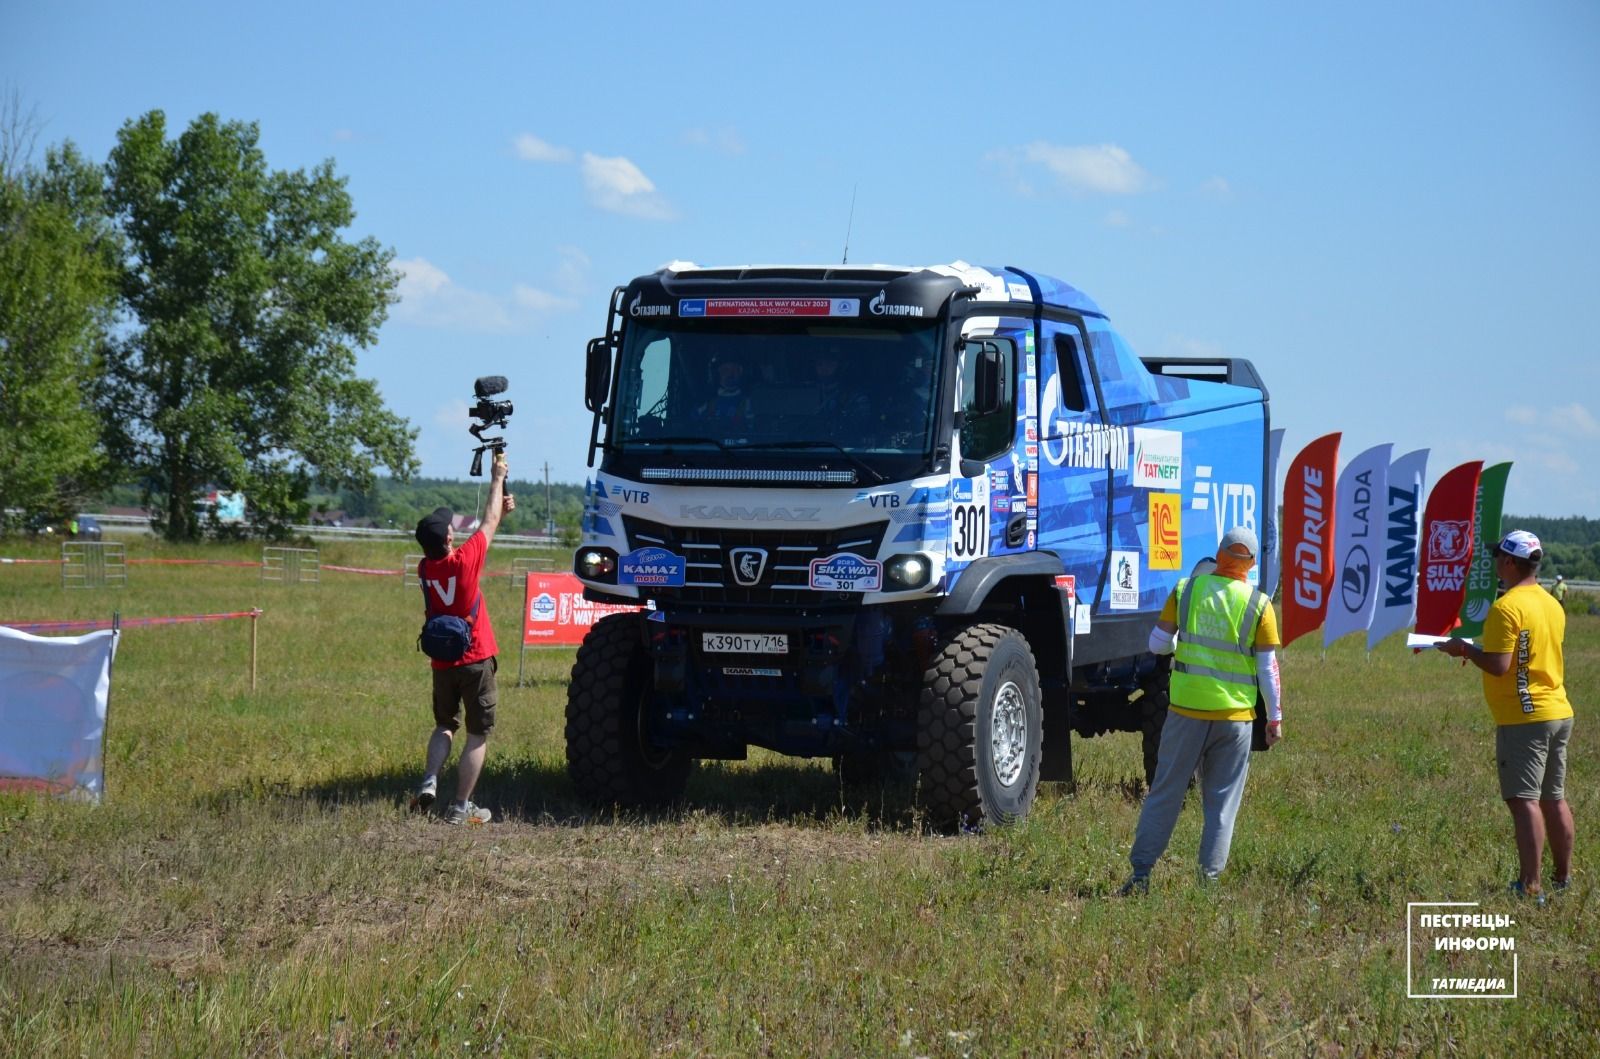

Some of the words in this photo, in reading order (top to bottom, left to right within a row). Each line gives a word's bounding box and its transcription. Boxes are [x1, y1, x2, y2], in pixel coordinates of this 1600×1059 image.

[640, 305, 671, 316] ГАЗПРОМ
[885, 305, 923, 317] ГАЗПРОМ
[1068, 421, 1128, 470] ГАЗПРОМ
[1144, 464, 1179, 480] TATNEFT
[623, 489, 650, 504] VTB
[869, 494, 900, 508] VTB
[1352, 469, 1373, 538] LADA
[680, 505, 822, 521] KAMAZ
[954, 505, 986, 556] 301
[1385, 483, 1419, 608] KAMAZ
[623, 565, 678, 575] KAMAZ
[817, 565, 847, 575] SILK
[848, 566, 876, 576] WAY
[1427, 565, 1465, 579] SILK
[1469, 559, 1480, 591] РИА
[634, 575, 668, 584] master
[836, 580, 855, 590] 301
[1427, 579, 1464, 592] WAY
[573, 610, 594, 625] WAY
[763, 636, 784, 647] 716
[1519, 630, 1530, 665] TEAM
